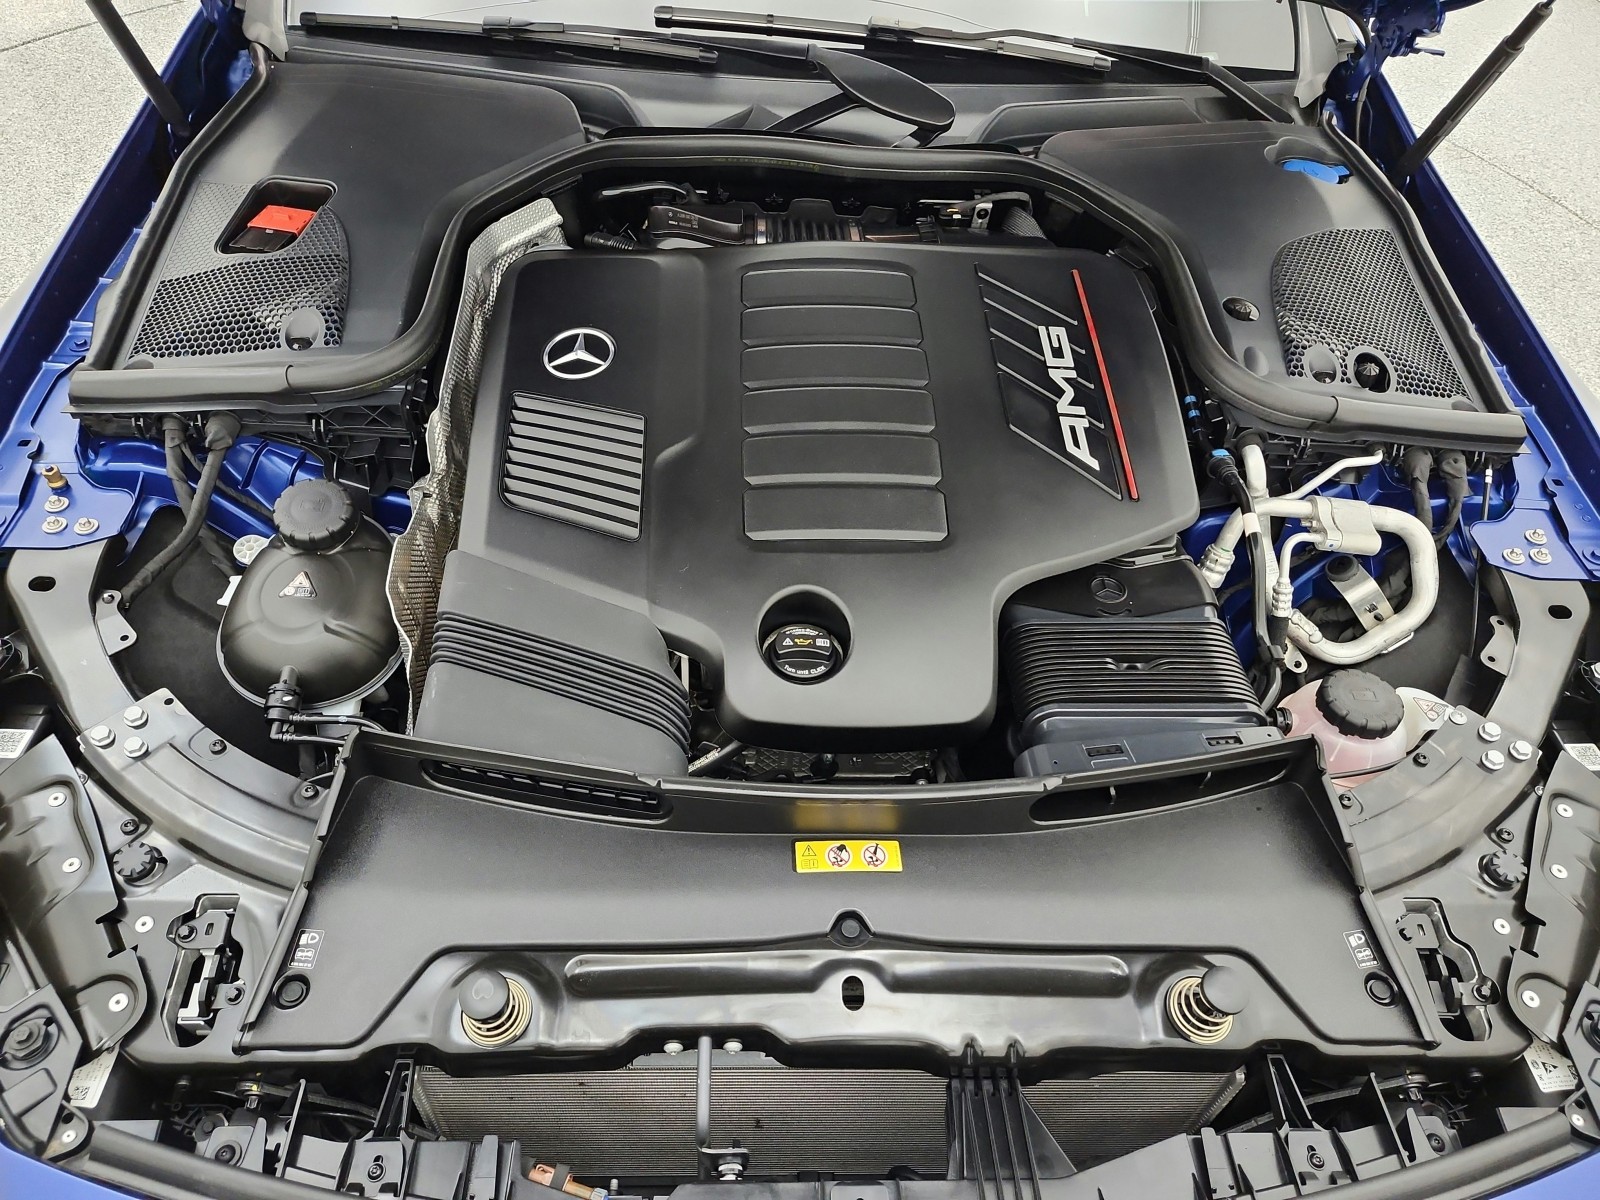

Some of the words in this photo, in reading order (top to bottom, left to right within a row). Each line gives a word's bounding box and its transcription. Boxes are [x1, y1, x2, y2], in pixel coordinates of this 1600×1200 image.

[1038, 326, 1100, 471] AMG
[784, 664, 796, 673] Turn
[810, 665, 827, 674] CLICK
